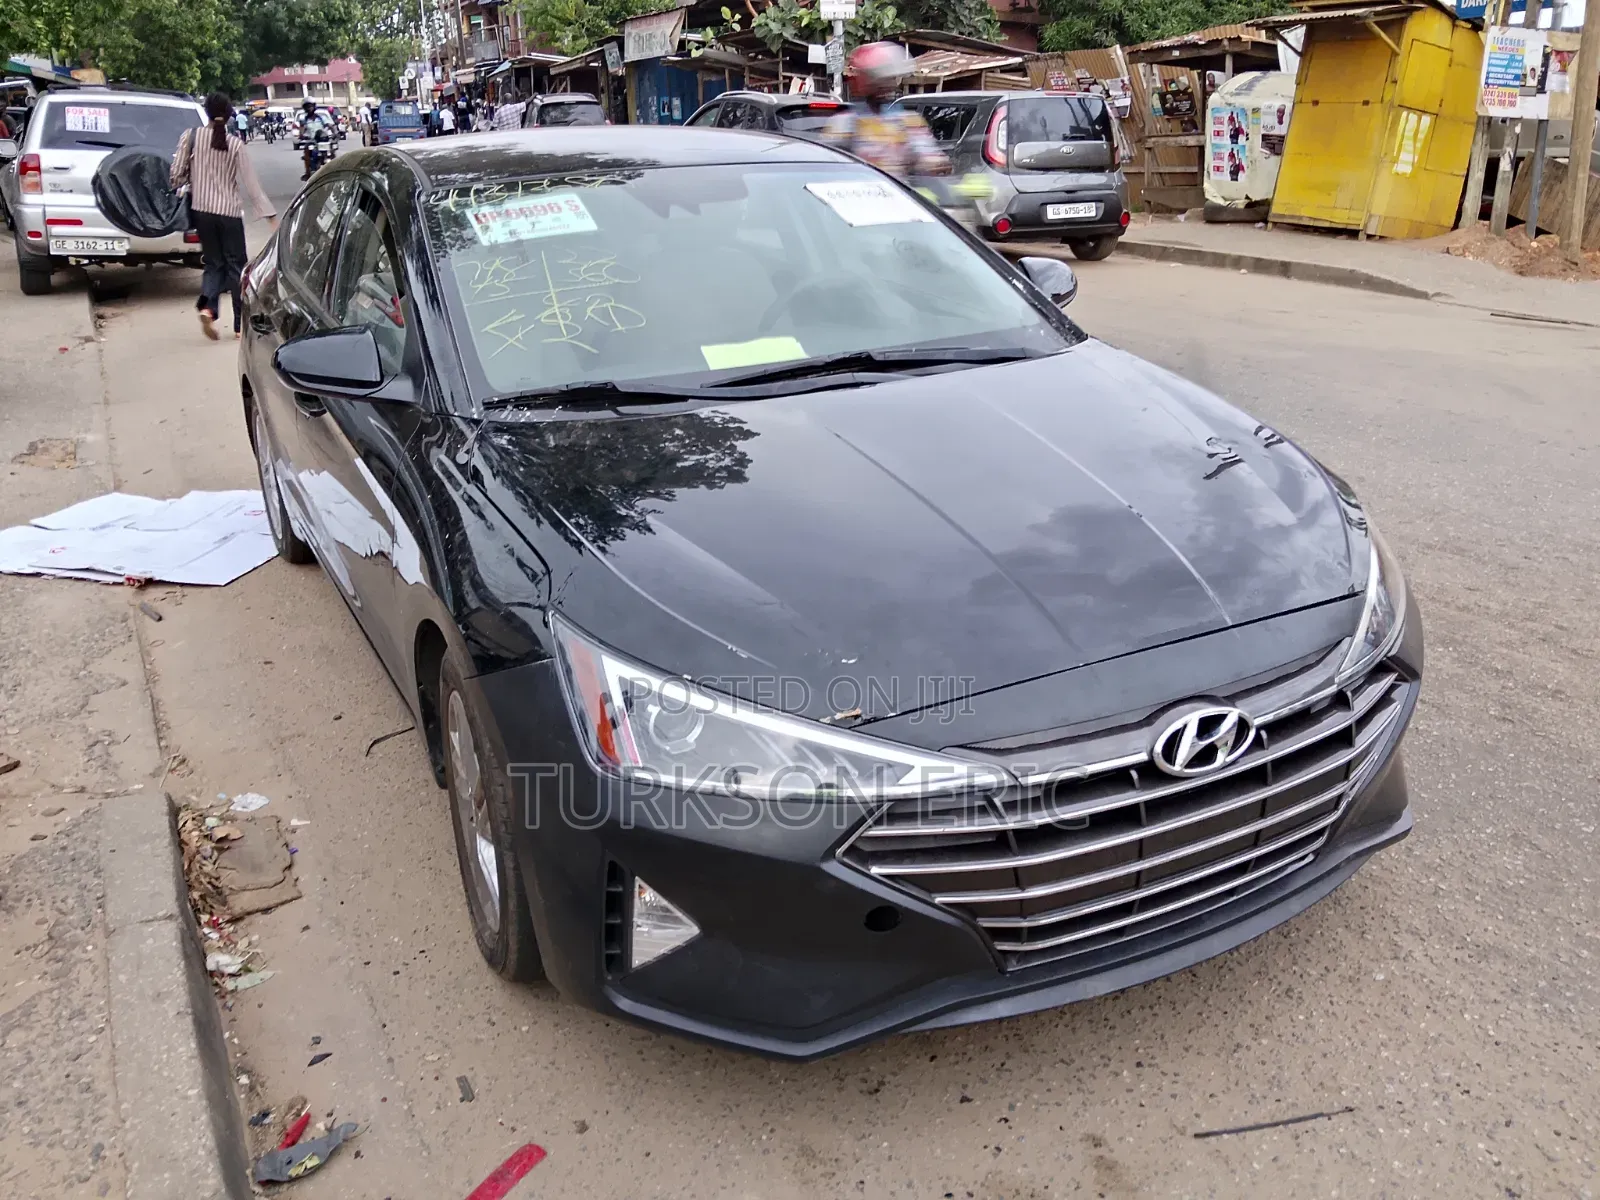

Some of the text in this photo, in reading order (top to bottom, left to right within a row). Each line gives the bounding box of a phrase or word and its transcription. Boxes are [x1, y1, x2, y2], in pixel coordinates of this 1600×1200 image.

[1493, 36, 1525, 47] TEACHERS
[66, 108, 108, 117] FOR SALE
[55, 240, 116, 251] GE 3162-11
